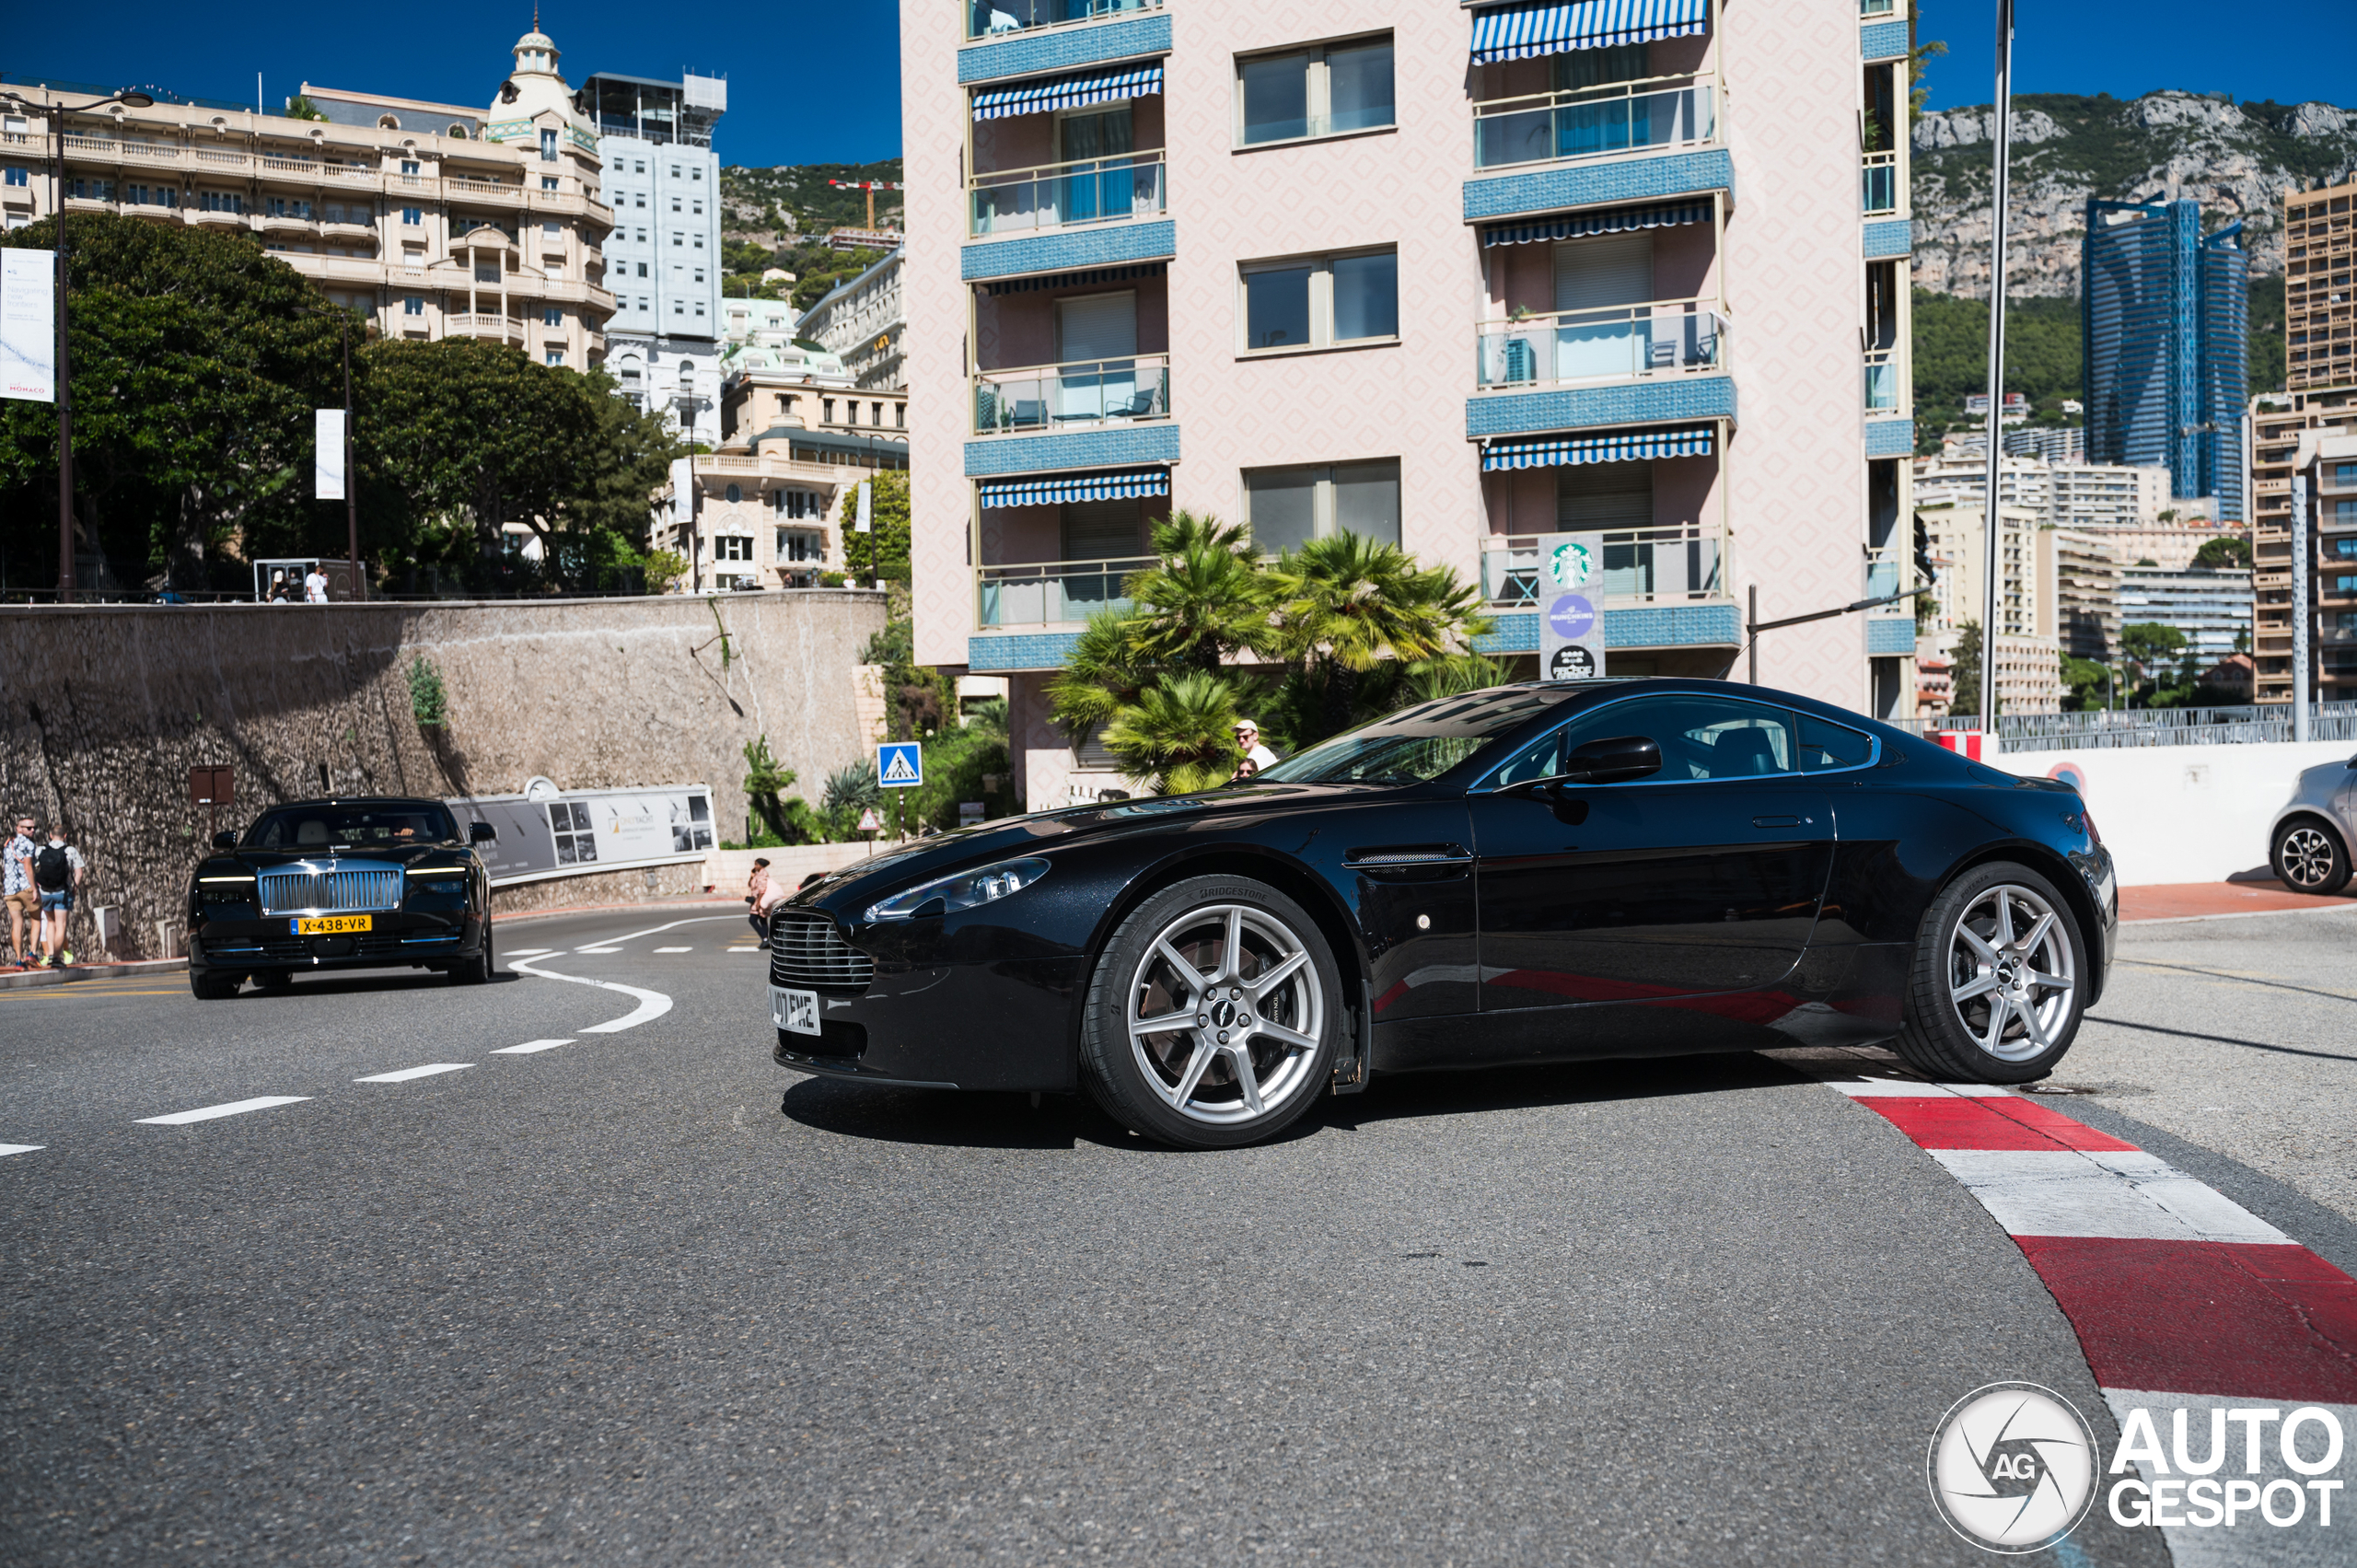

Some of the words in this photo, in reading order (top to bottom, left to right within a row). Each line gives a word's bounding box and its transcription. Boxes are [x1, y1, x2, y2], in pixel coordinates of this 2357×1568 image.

[9, 386, 45, 394] MONACO
[1550, 612, 1593, 621] MUNCHKINS
[1552, 665, 1593, 675] ARCADE
[1960, 874, 1990, 900] POTENZA
[1199, 887, 1268, 902] BRIDGESTONE
[304, 918, 366, 932] X-438-VR
